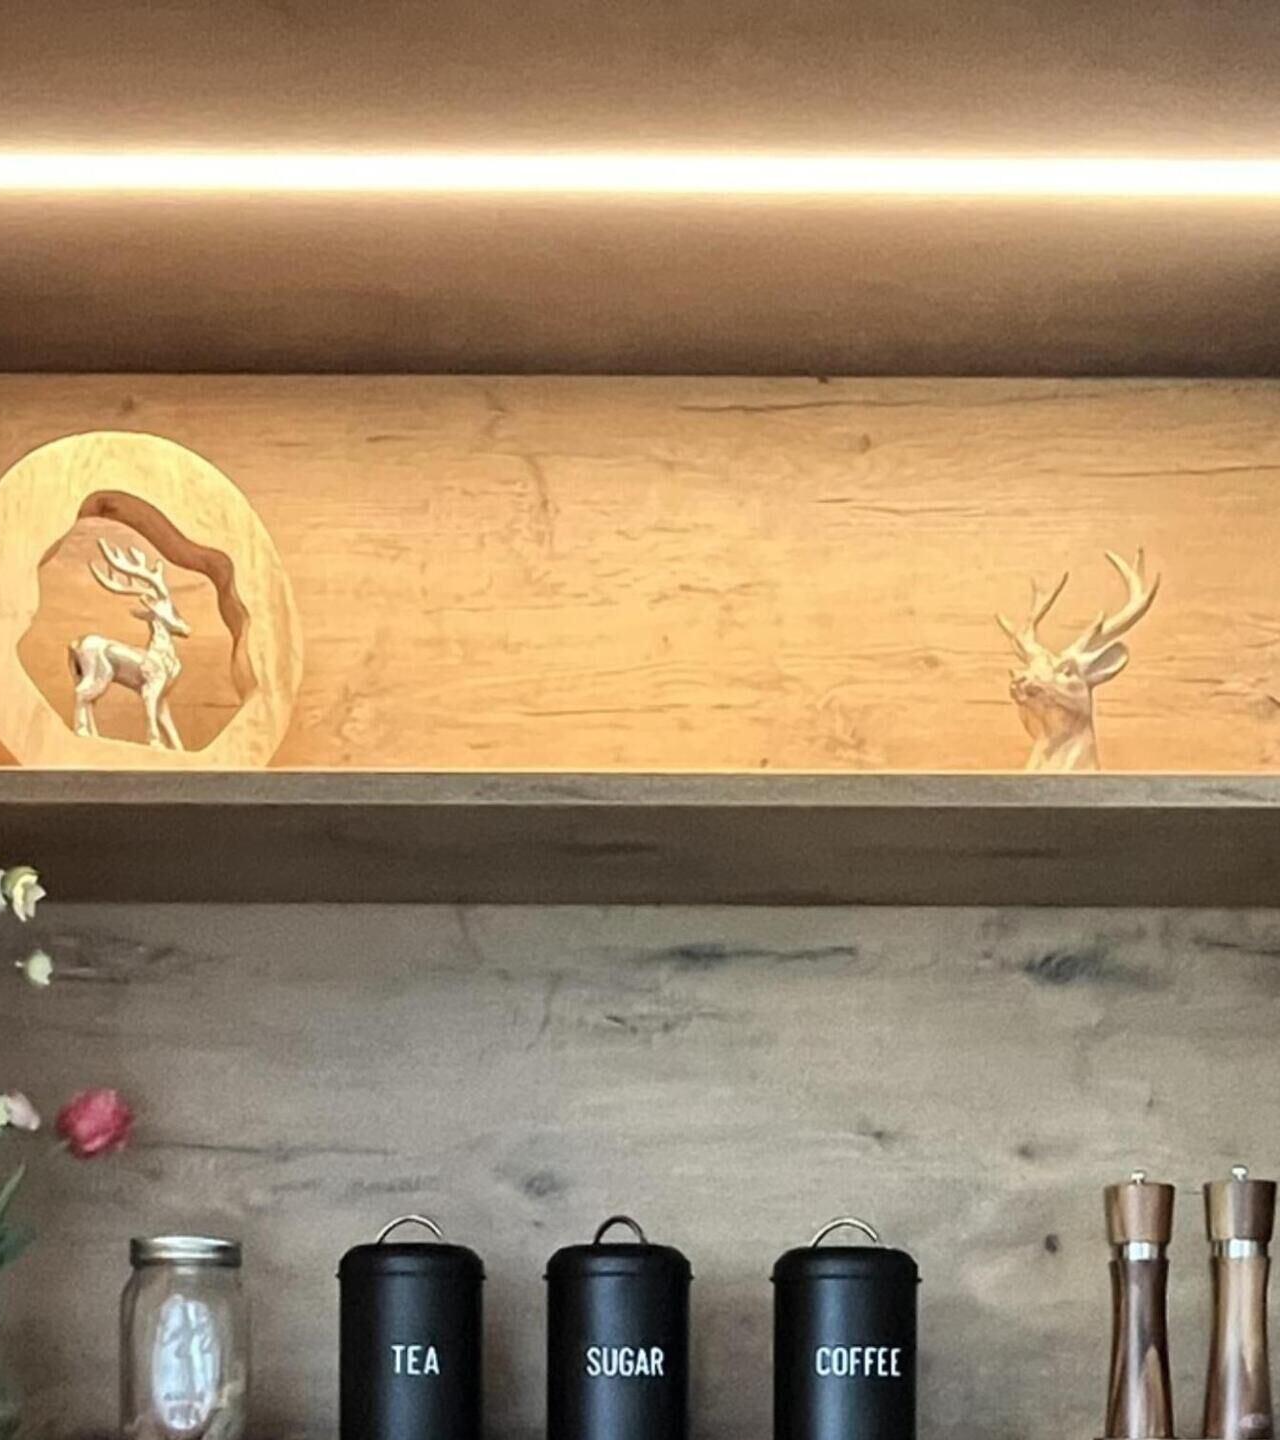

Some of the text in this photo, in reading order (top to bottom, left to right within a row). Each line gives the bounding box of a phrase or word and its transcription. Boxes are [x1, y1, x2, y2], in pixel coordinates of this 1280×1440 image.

[391, 1345, 440, 1375] TEA
[586, 1347, 664, 1377] SUGAR
[815, 1346, 901, 1377] COFFEE
